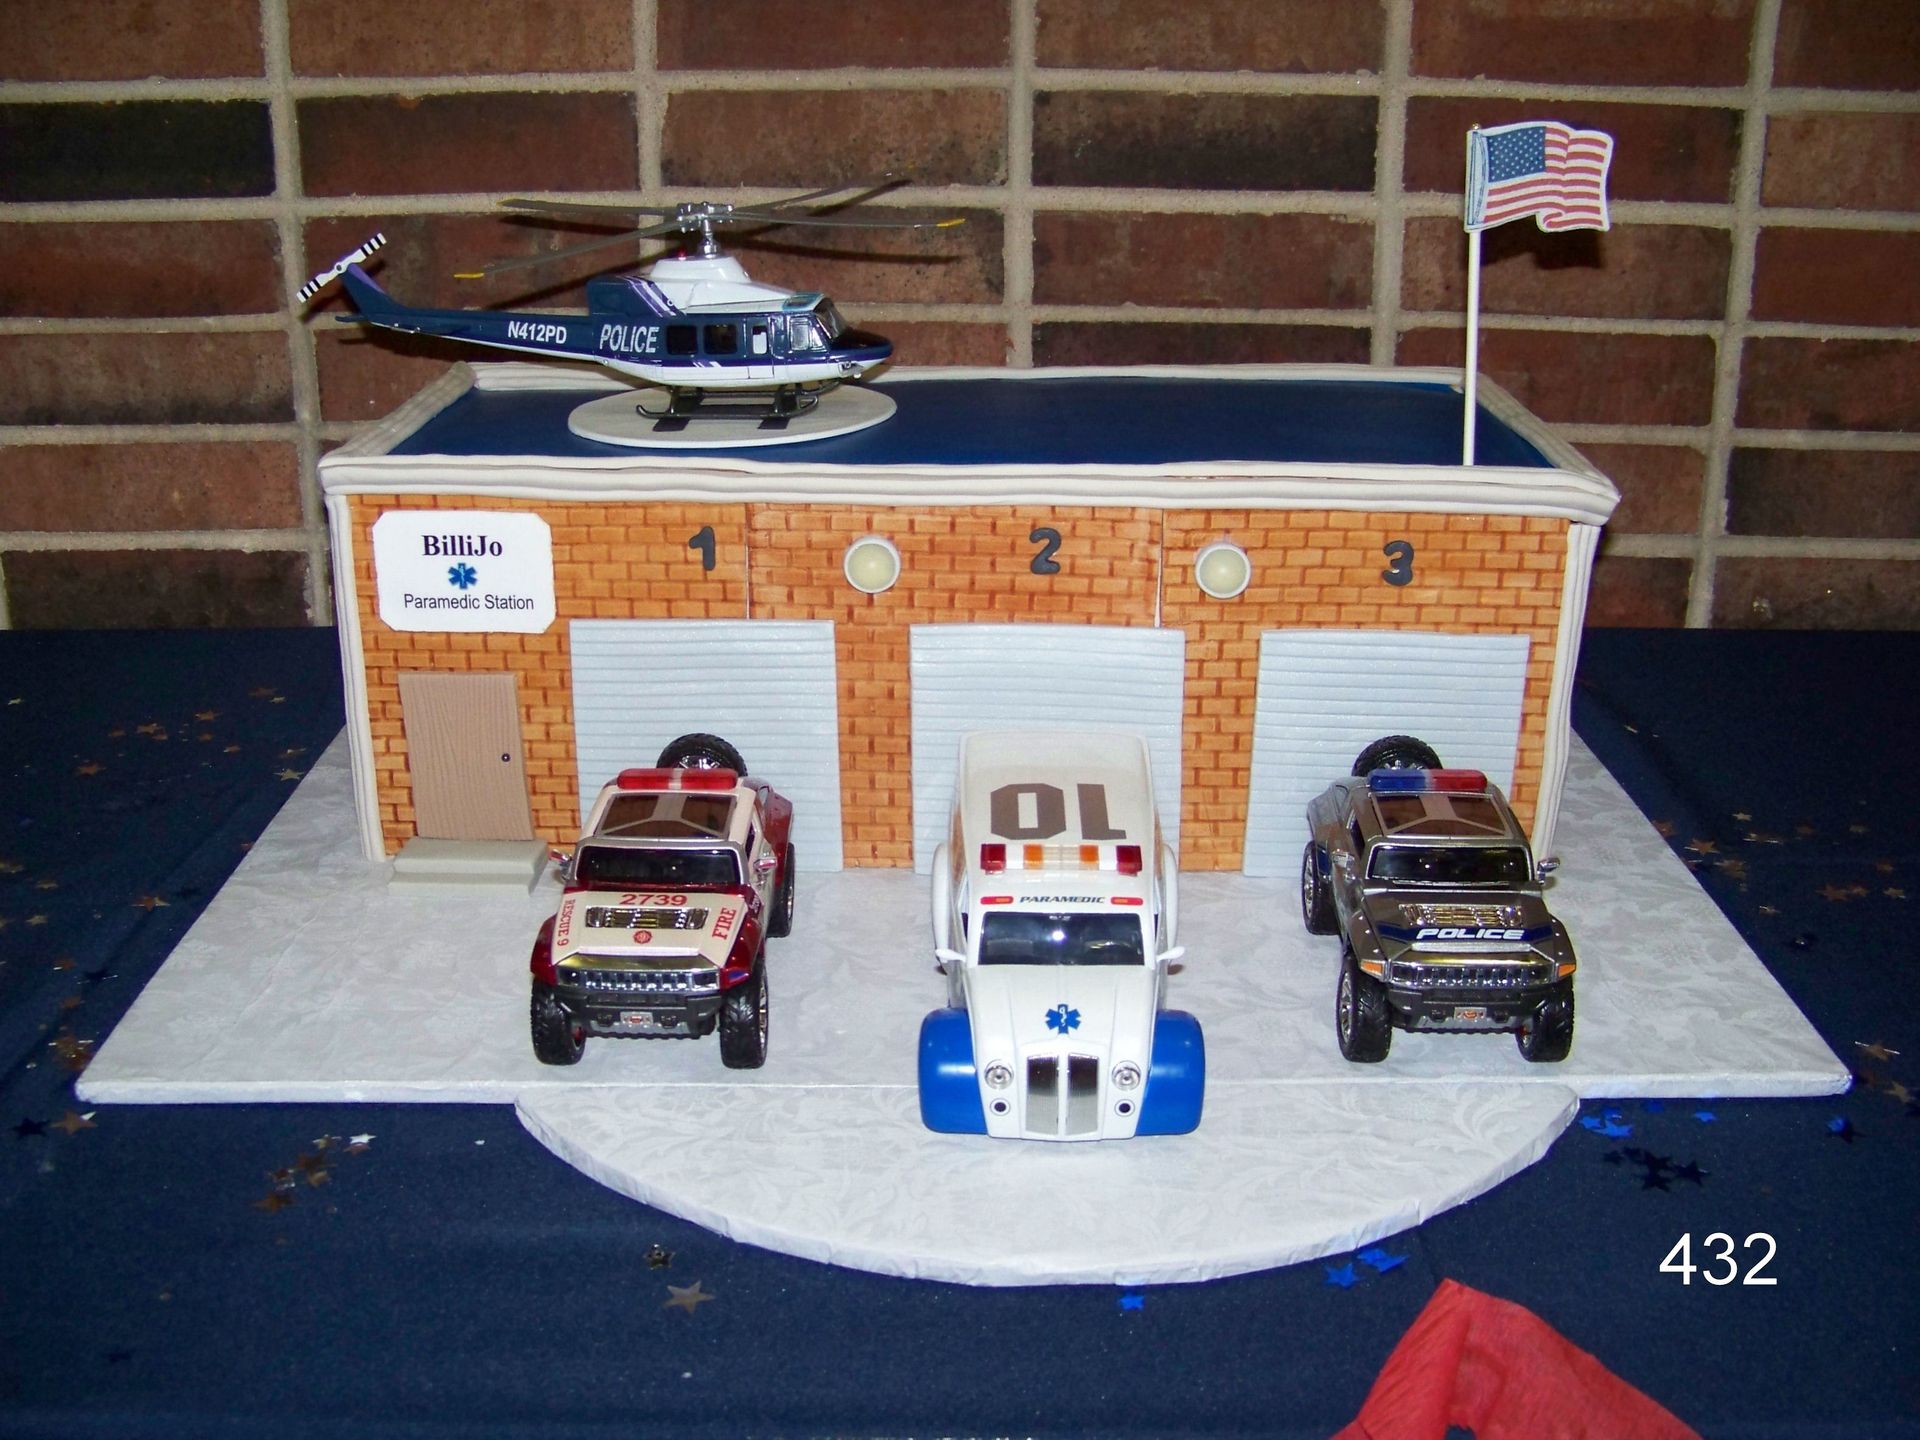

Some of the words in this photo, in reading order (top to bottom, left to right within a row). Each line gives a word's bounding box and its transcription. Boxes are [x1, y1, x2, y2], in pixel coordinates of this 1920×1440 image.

[507, 321, 567, 344] N412PD
[598, 323, 661, 353] POLICE
[422, 534, 503, 557] BilliJo
[689, 526, 716, 571] 1
[1028, 527, 1061, 575] 2
[1382, 540, 1414, 586] 3
[404, 593, 480, 610] Paramedic
[484, 594, 534, 611] Station
[619, 893, 688, 906] 2739
[1019, 896, 1107, 905] PARAMEDIC
[558, 898, 576, 937] RESCUE
[712, 907, 737, 940] FIRE
[1416, 928, 1525, 940] POLICE
